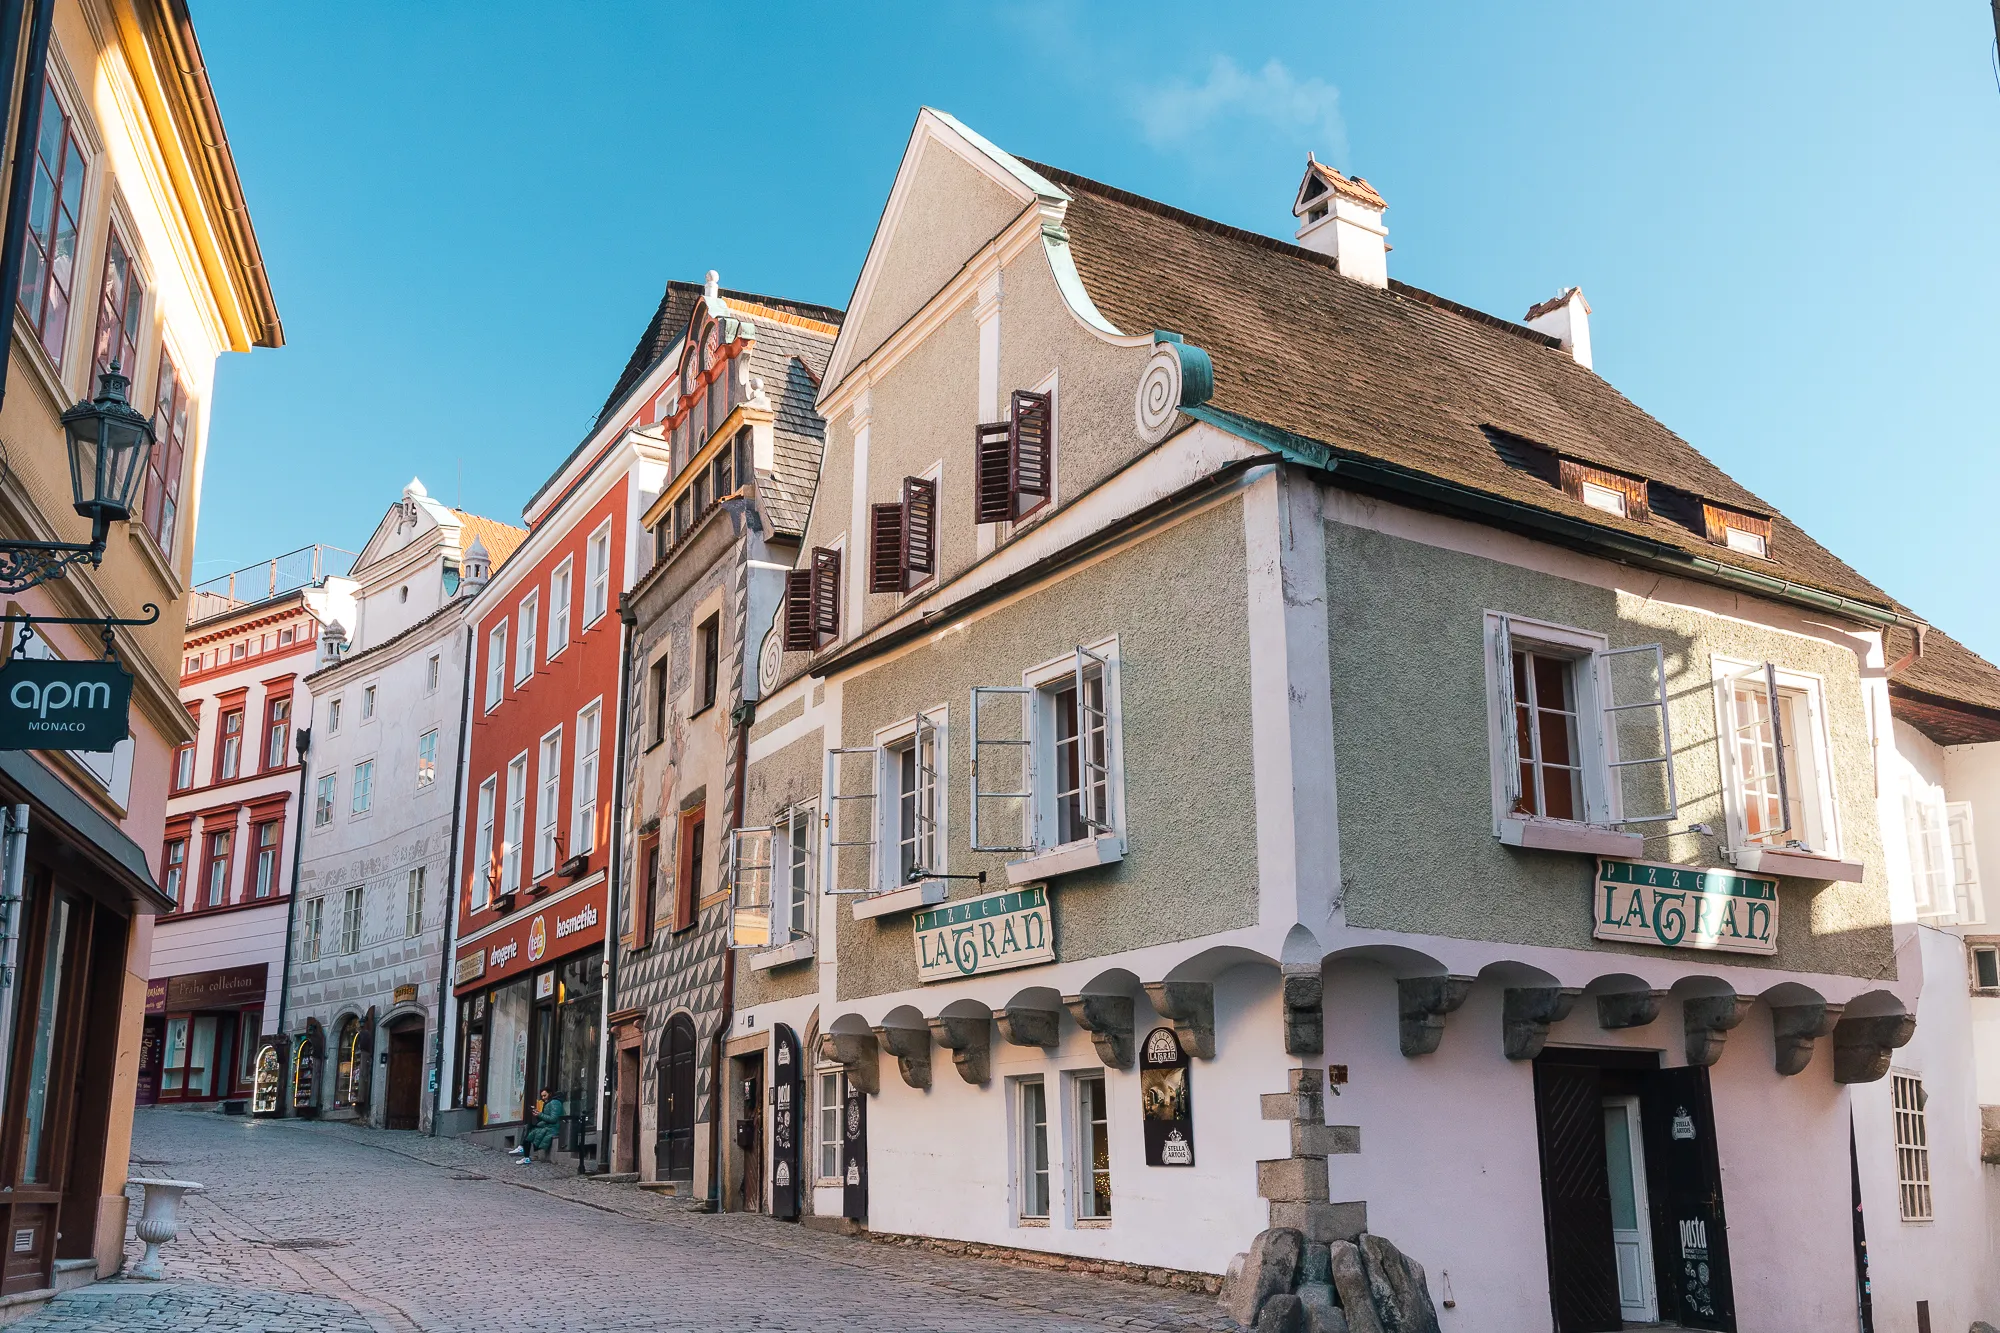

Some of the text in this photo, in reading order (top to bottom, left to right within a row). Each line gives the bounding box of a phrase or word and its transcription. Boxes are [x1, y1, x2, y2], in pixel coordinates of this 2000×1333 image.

[10, 681, 110, 718] apm
[28, 722, 86, 731] MONACO
[1607, 862, 1770, 898] PIZZERIA
[919, 889, 1041, 929] PIZZERIA
[490, 938, 518, 968] drogerie
[556, 903, 598, 938] kosmetika
[147, 984, 165, 998] ension
[179, 975, 252, 995] Praha collection
[1679, 1216, 1707, 1258] pasta
